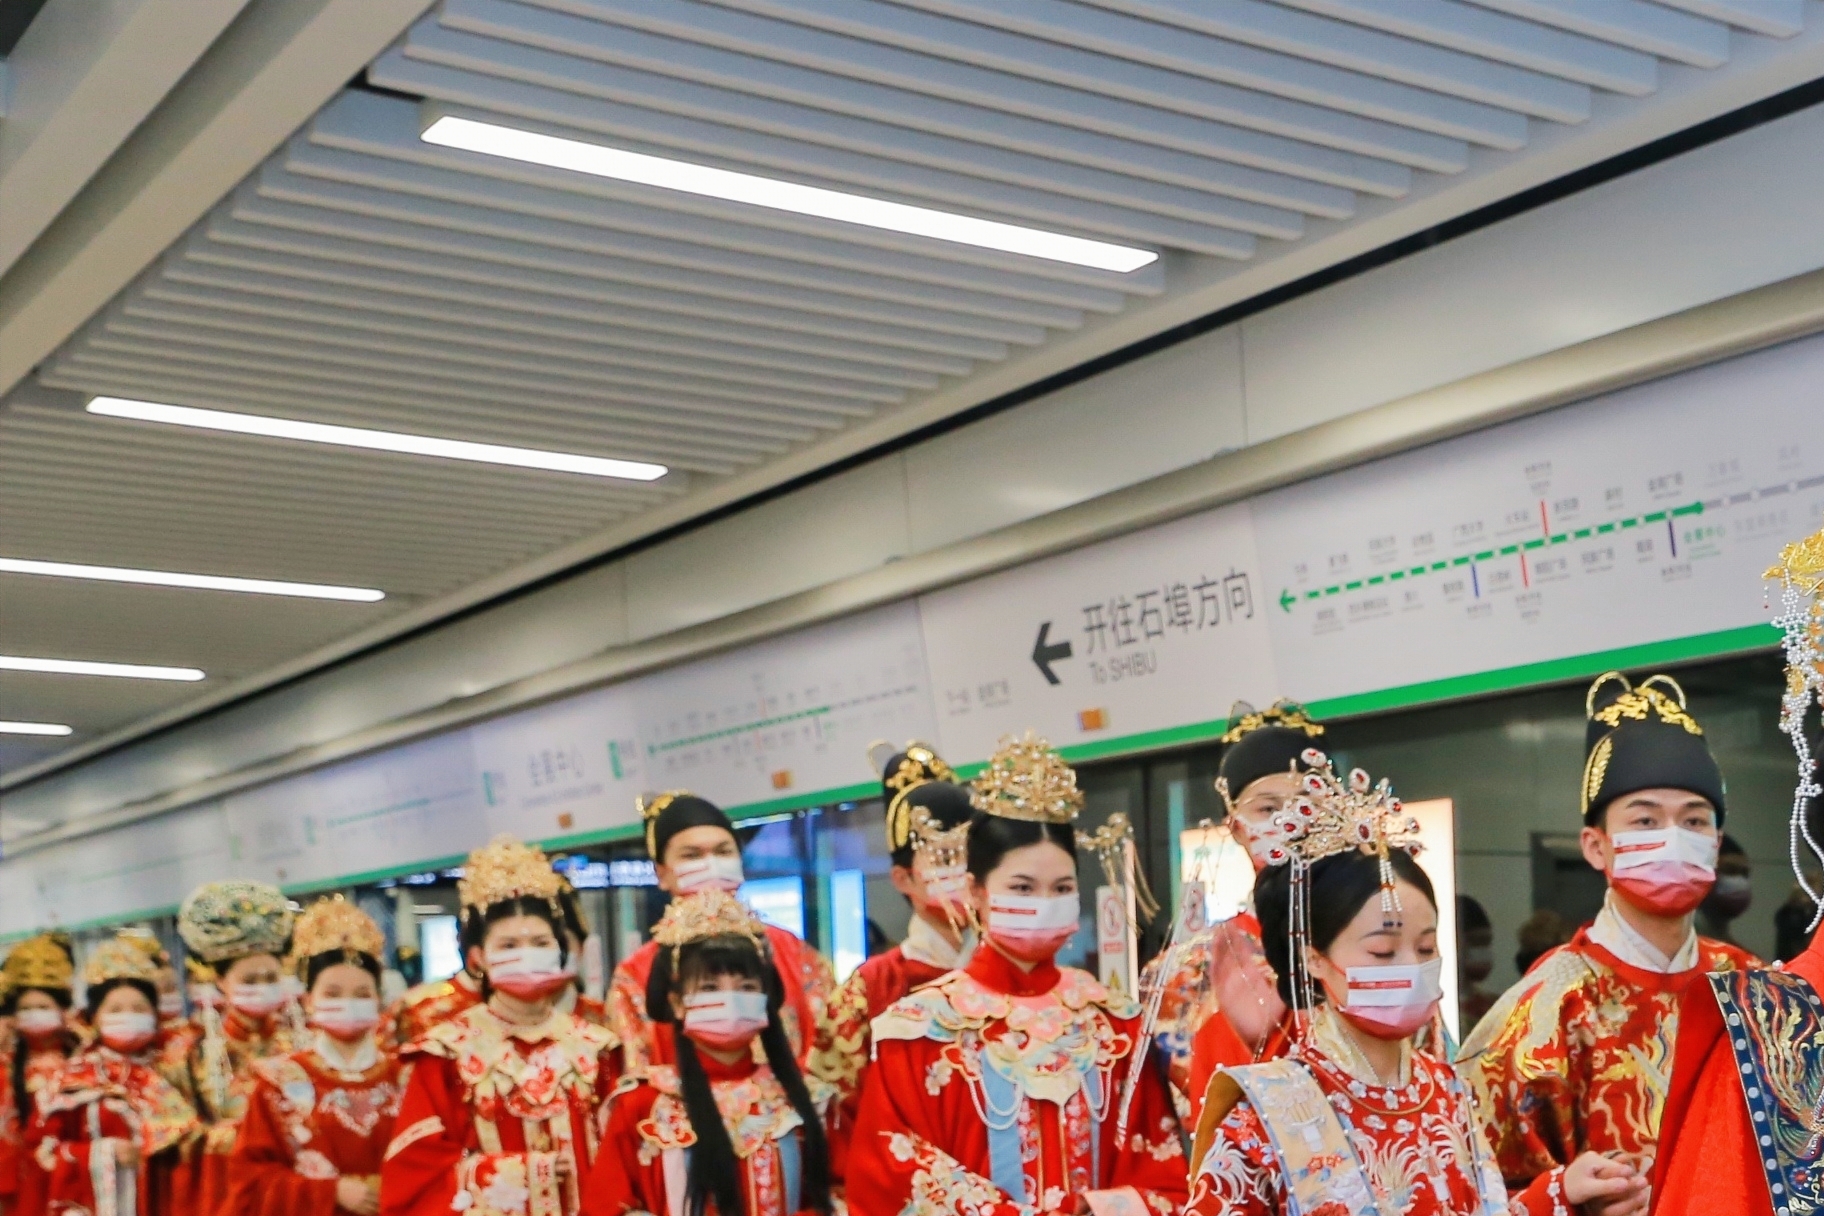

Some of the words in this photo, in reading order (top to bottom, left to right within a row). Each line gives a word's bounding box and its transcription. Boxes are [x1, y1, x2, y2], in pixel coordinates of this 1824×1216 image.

[1082, 567, 1255, 654] 开往石埠方向
[1088, 660, 1107, 684] To
[1110, 650, 1158, 682] SHIBU
